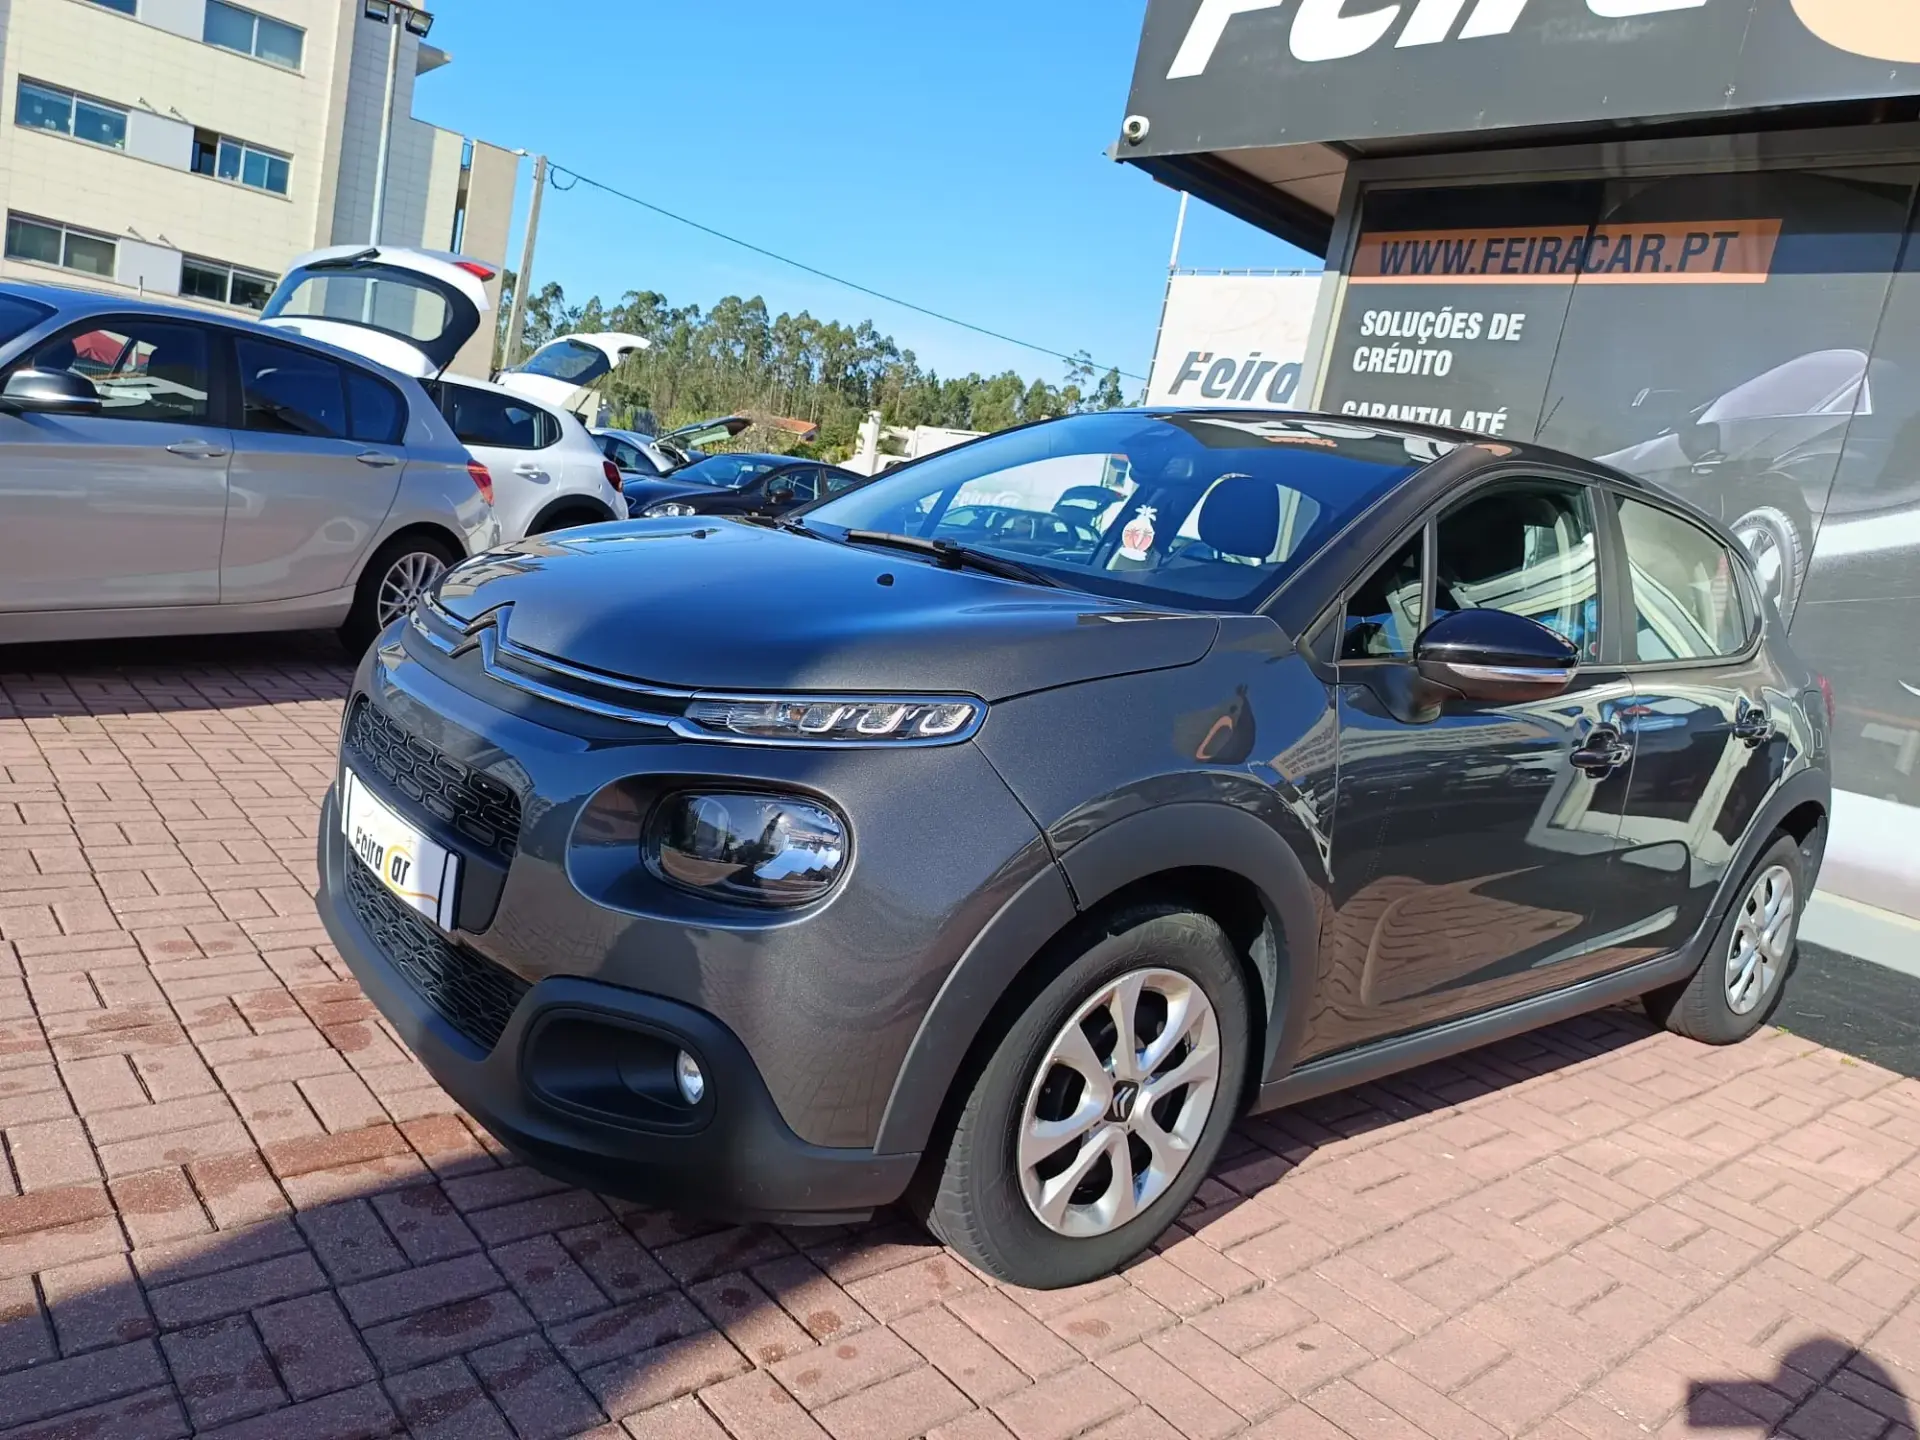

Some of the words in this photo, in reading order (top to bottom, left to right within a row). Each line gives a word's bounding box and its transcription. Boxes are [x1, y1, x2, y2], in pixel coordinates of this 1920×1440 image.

[1379, 231, 1740, 275] WWW.FEIRACAR.PT
[1360, 306, 1484, 344] SOLUÇÕES
[1487, 313, 1526, 341] DE
[1352, 342, 1453, 377] CRÉDITO
[1460, 407, 1509, 436] ATÉ
